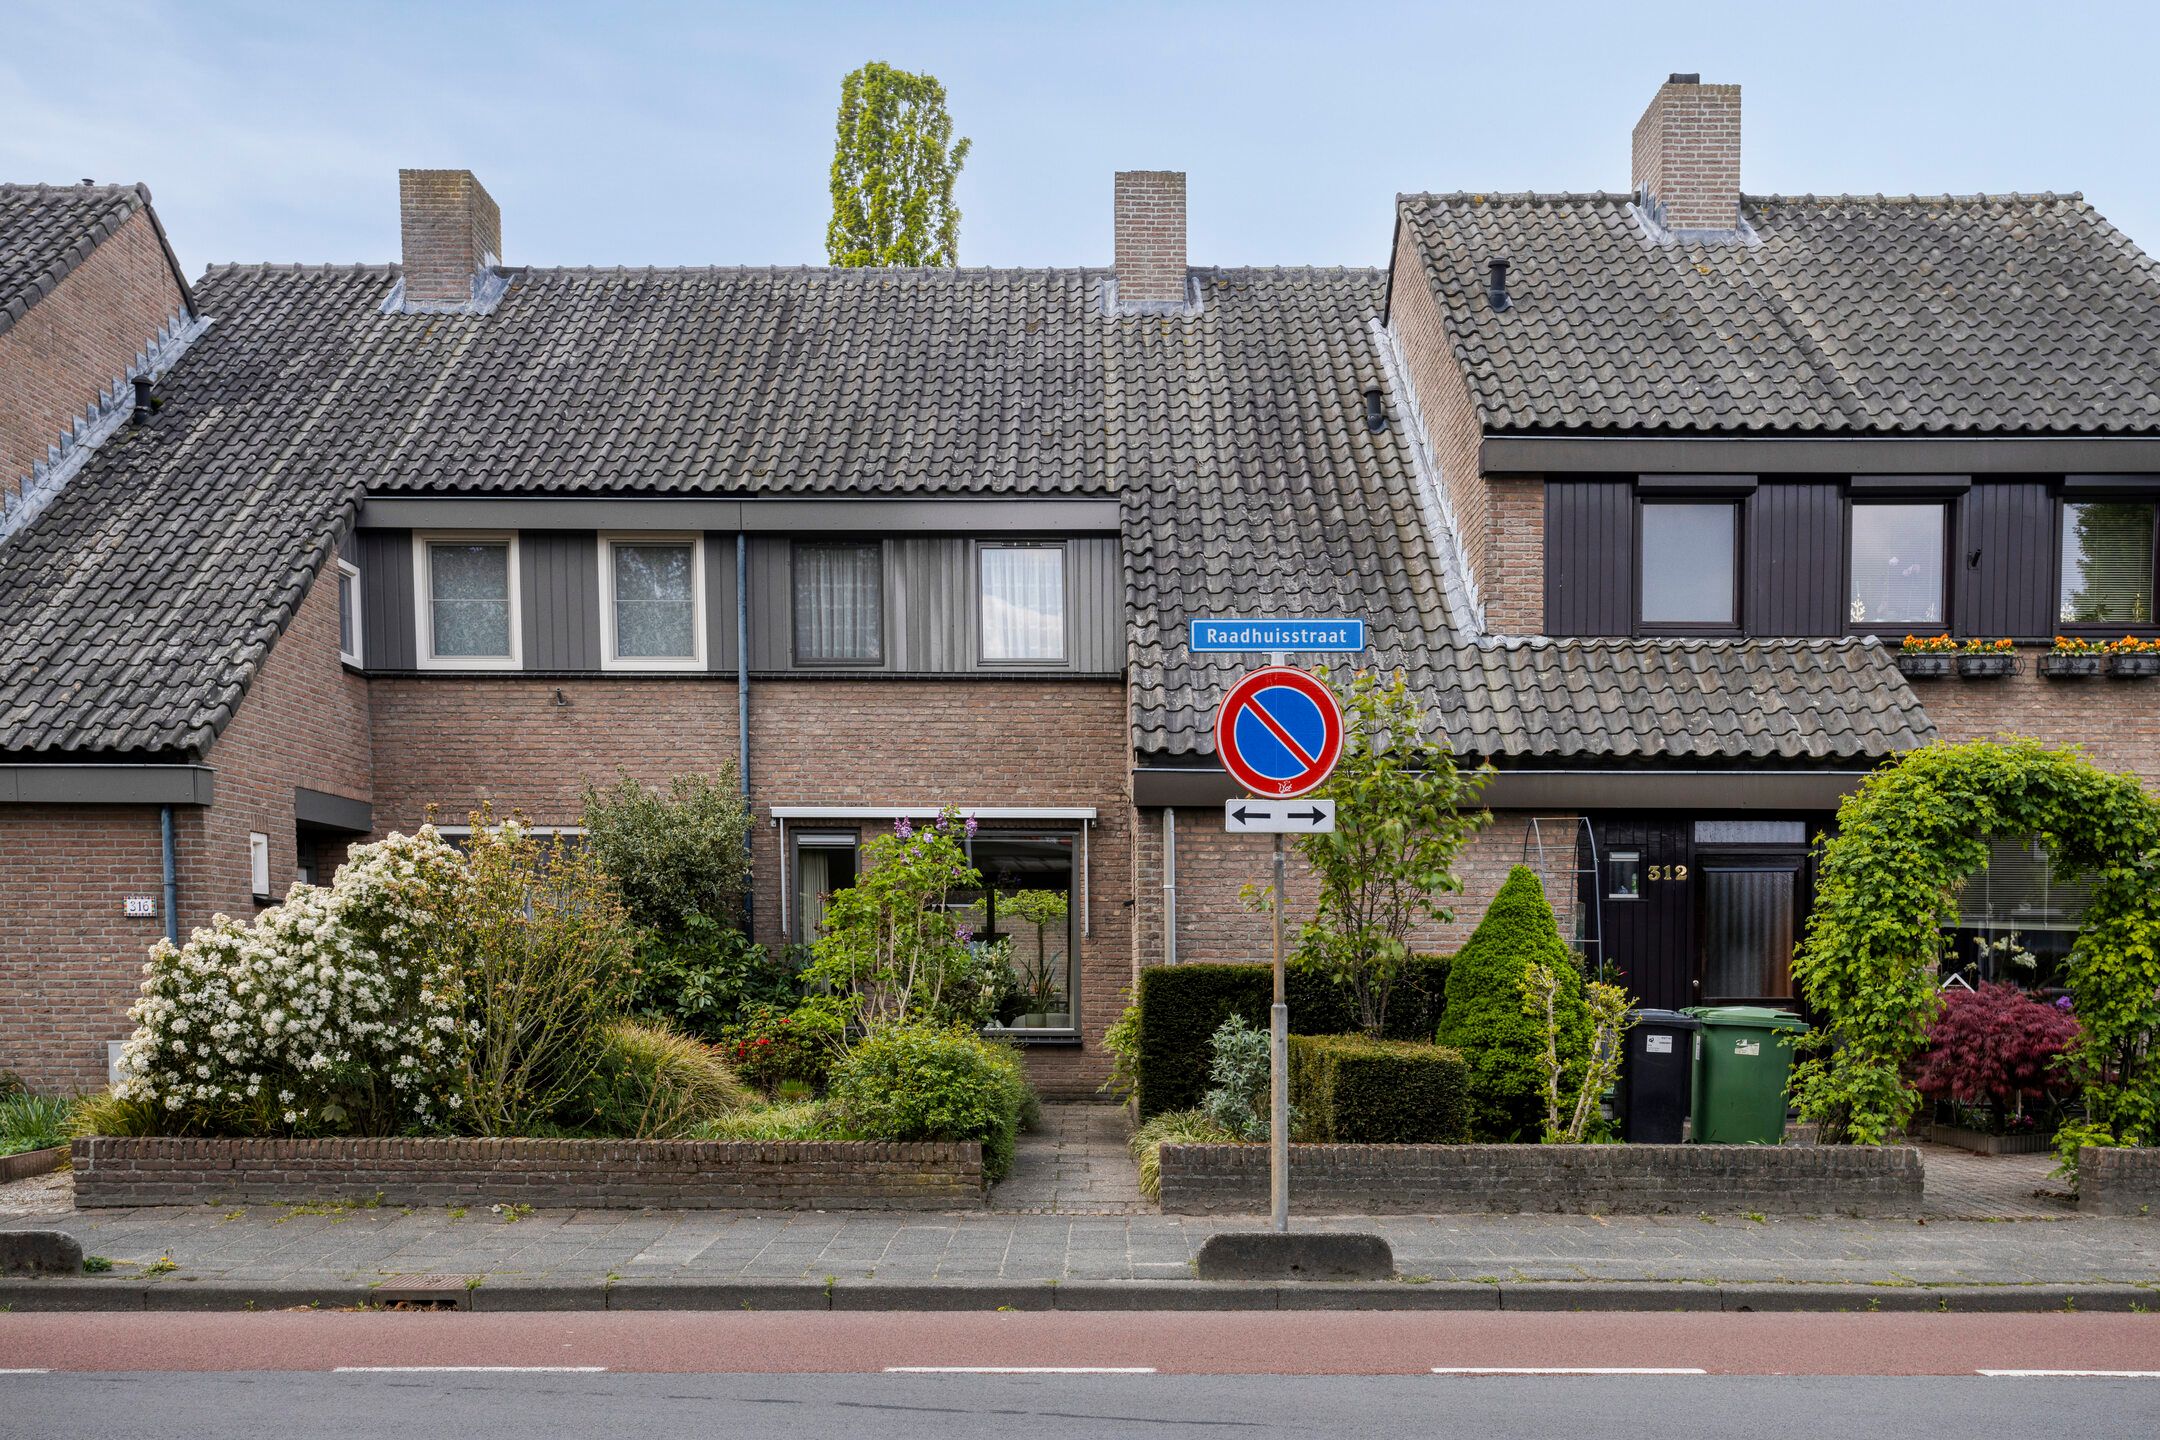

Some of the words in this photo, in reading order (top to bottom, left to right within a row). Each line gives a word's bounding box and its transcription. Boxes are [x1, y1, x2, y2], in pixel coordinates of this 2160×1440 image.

[1207, 628, 1347, 643] Raadhuisstraat
[1647, 865, 1688, 881] 312
[130, 900, 150, 912] 316
